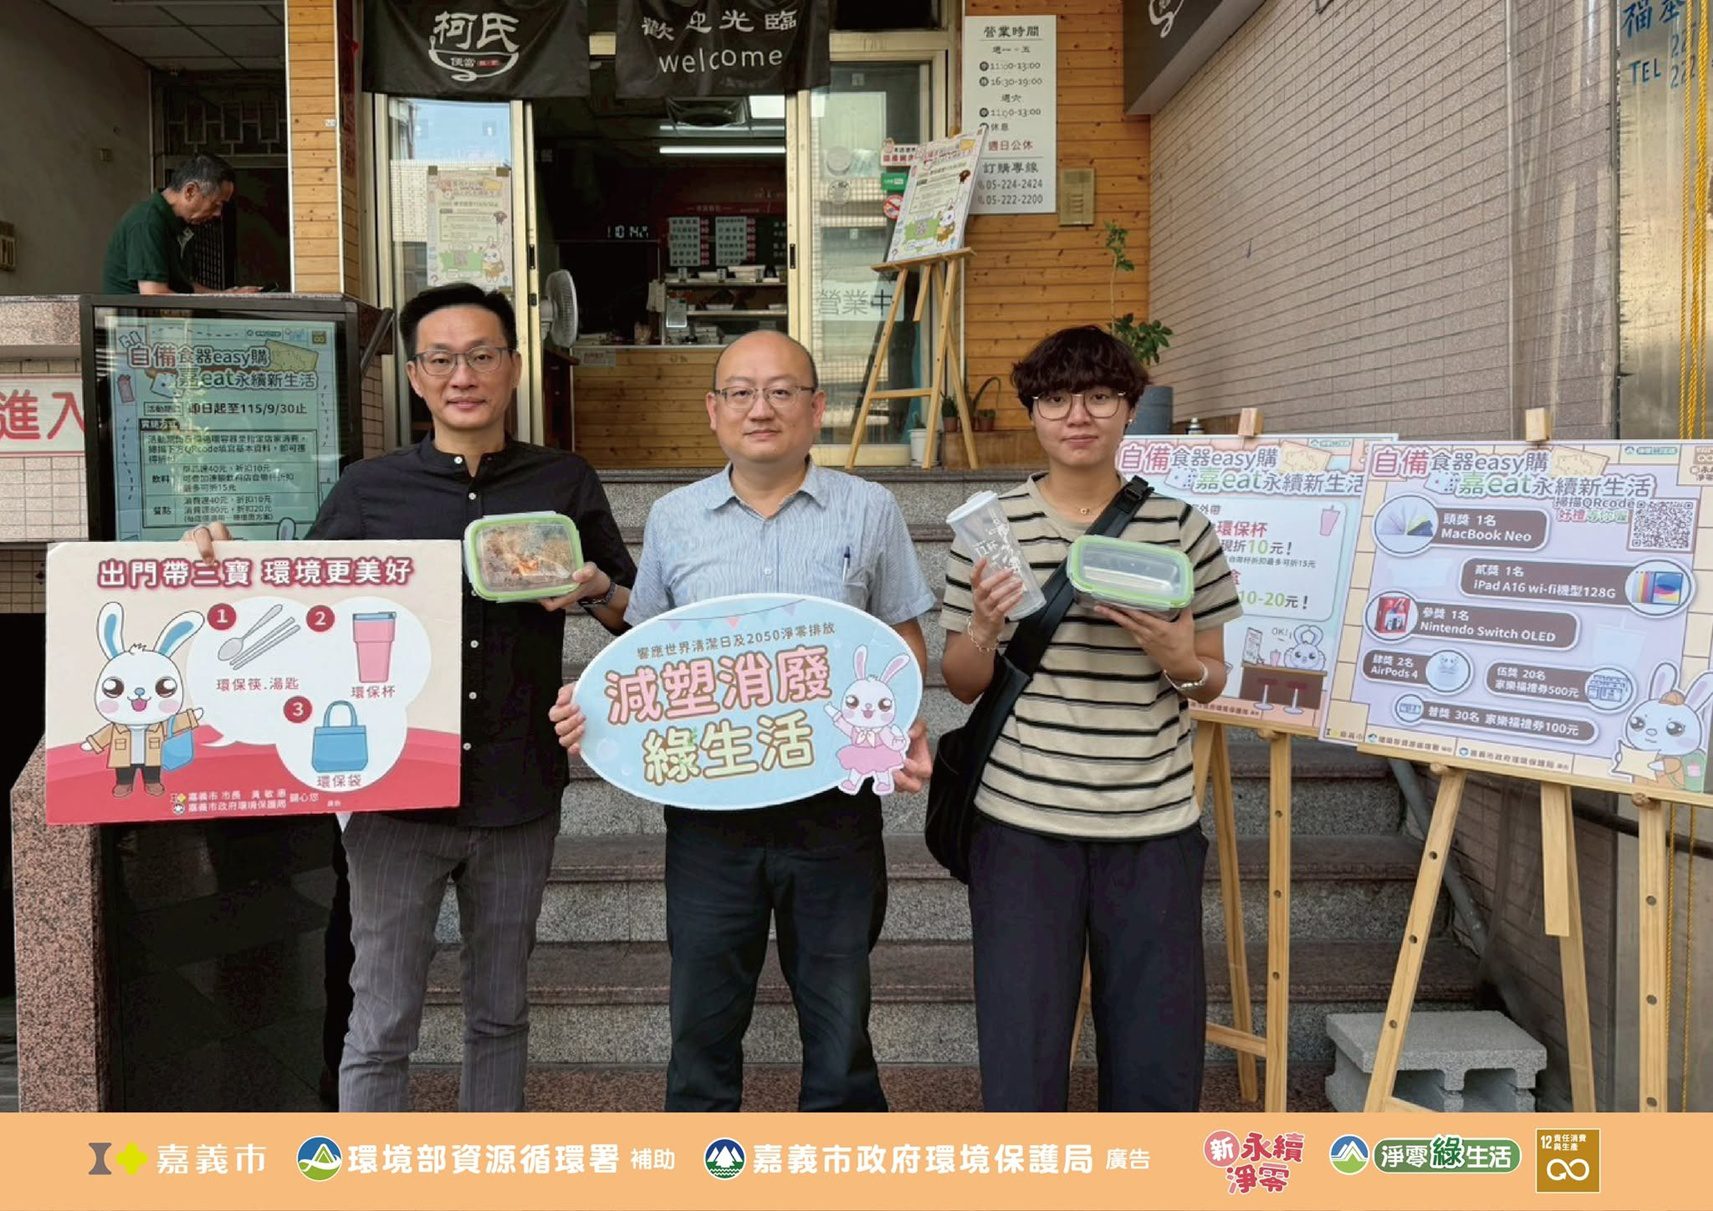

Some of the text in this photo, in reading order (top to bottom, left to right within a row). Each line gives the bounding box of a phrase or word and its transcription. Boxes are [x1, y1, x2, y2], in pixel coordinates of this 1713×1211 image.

[433, 11, 520, 52] 柯氏
[641, 9, 798, 41] 歡迎光臨
[984, 25, 1039, 38] 營業時間
[658, 48, 783, 73] welcome
[1629, 58, 1661, 86] TEL
[988, 140, 1033, 151] 週日公休
[983, 162, 1039, 173] 訂購專線
[986, 179, 1043, 190] 05-224-2424
[986, 194, 1043, 205] 05-222-2200
[817, 288, 893, 316] 營業中
[131, 345, 270, 368] 自備食器easy購
[179, 367, 316, 388] 嘉eat永續新生活
[0, 388, 87, 439] 進入
[190, 403, 307, 414] 即日起至115/9/30止
[1121, 446, 1279, 470] 自備食器easy購
[1373, 450, 1548, 476] 自備食器easy購
[1459, 474, 1652, 497] 嘉eat永續新生活
[1477, 515, 1497, 527] 1名
[1217, 521, 1268, 538] 環保杯
[1441, 528, 1532, 542] MacBook Neo
[99, 557, 413, 587] 出門帶三寶 環境更美好
[1505, 566, 1525, 577] 1名
[1474, 580, 1500, 591] iPad
[1502, 582, 1526, 593] A16
[216, 609, 229, 624] 1
[315, 611, 327, 626] 2
[1452, 610, 1470, 621] 1名
[1420, 622, 1556, 642] Nintendo Switch OLED
[637, 622, 837, 660] 響應世界清潔日及2050淨零排放
[1398, 657, 1415, 668] 2名
[1371, 666, 1409, 678] AirPods
[1522, 669, 1547, 681] 20名
[351, 685, 396, 698] 環保杯
[604, 645, 833, 726] 減塑消廢
[293, 701, 304, 717] 3
[1455, 710, 1480, 722] 30名
[643, 709, 816, 786] 綠生活
[317, 774, 362, 788] 環保袋
